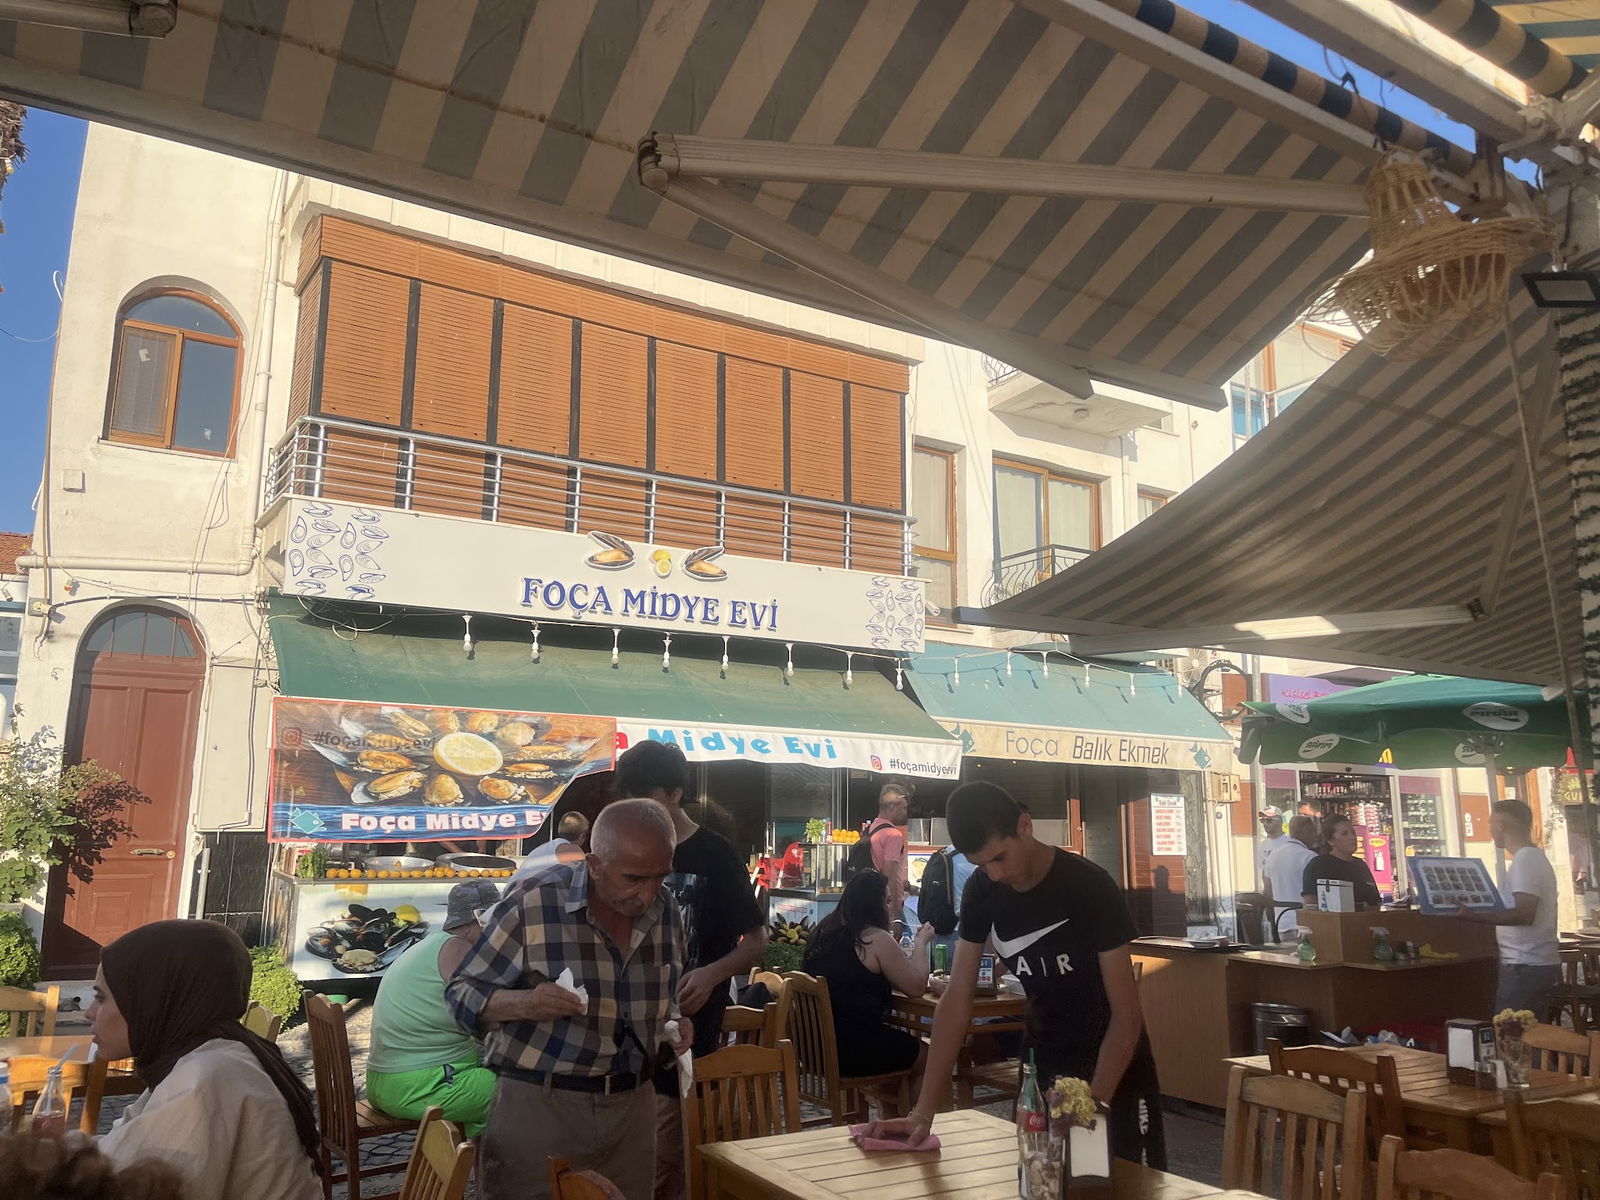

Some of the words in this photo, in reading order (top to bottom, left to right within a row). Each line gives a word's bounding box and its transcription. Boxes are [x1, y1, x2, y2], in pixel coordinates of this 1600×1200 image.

[521, 577, 613, 618] FOÇA
[622, 586, 721, 625] MİDYE
[729, 598, 779, 631] EVİ
[783, 736, 838, 759] Evi
[1005, 730, 1058, 758] Foça
[1072, 735, 1112, 761] Balık
[1119, 739, 1169, 765] Ekmek
[341, 813, 416, 834] Foça
[426, 811, 516, 831] Midye
[1015, 953, 1074, 978] AIR
